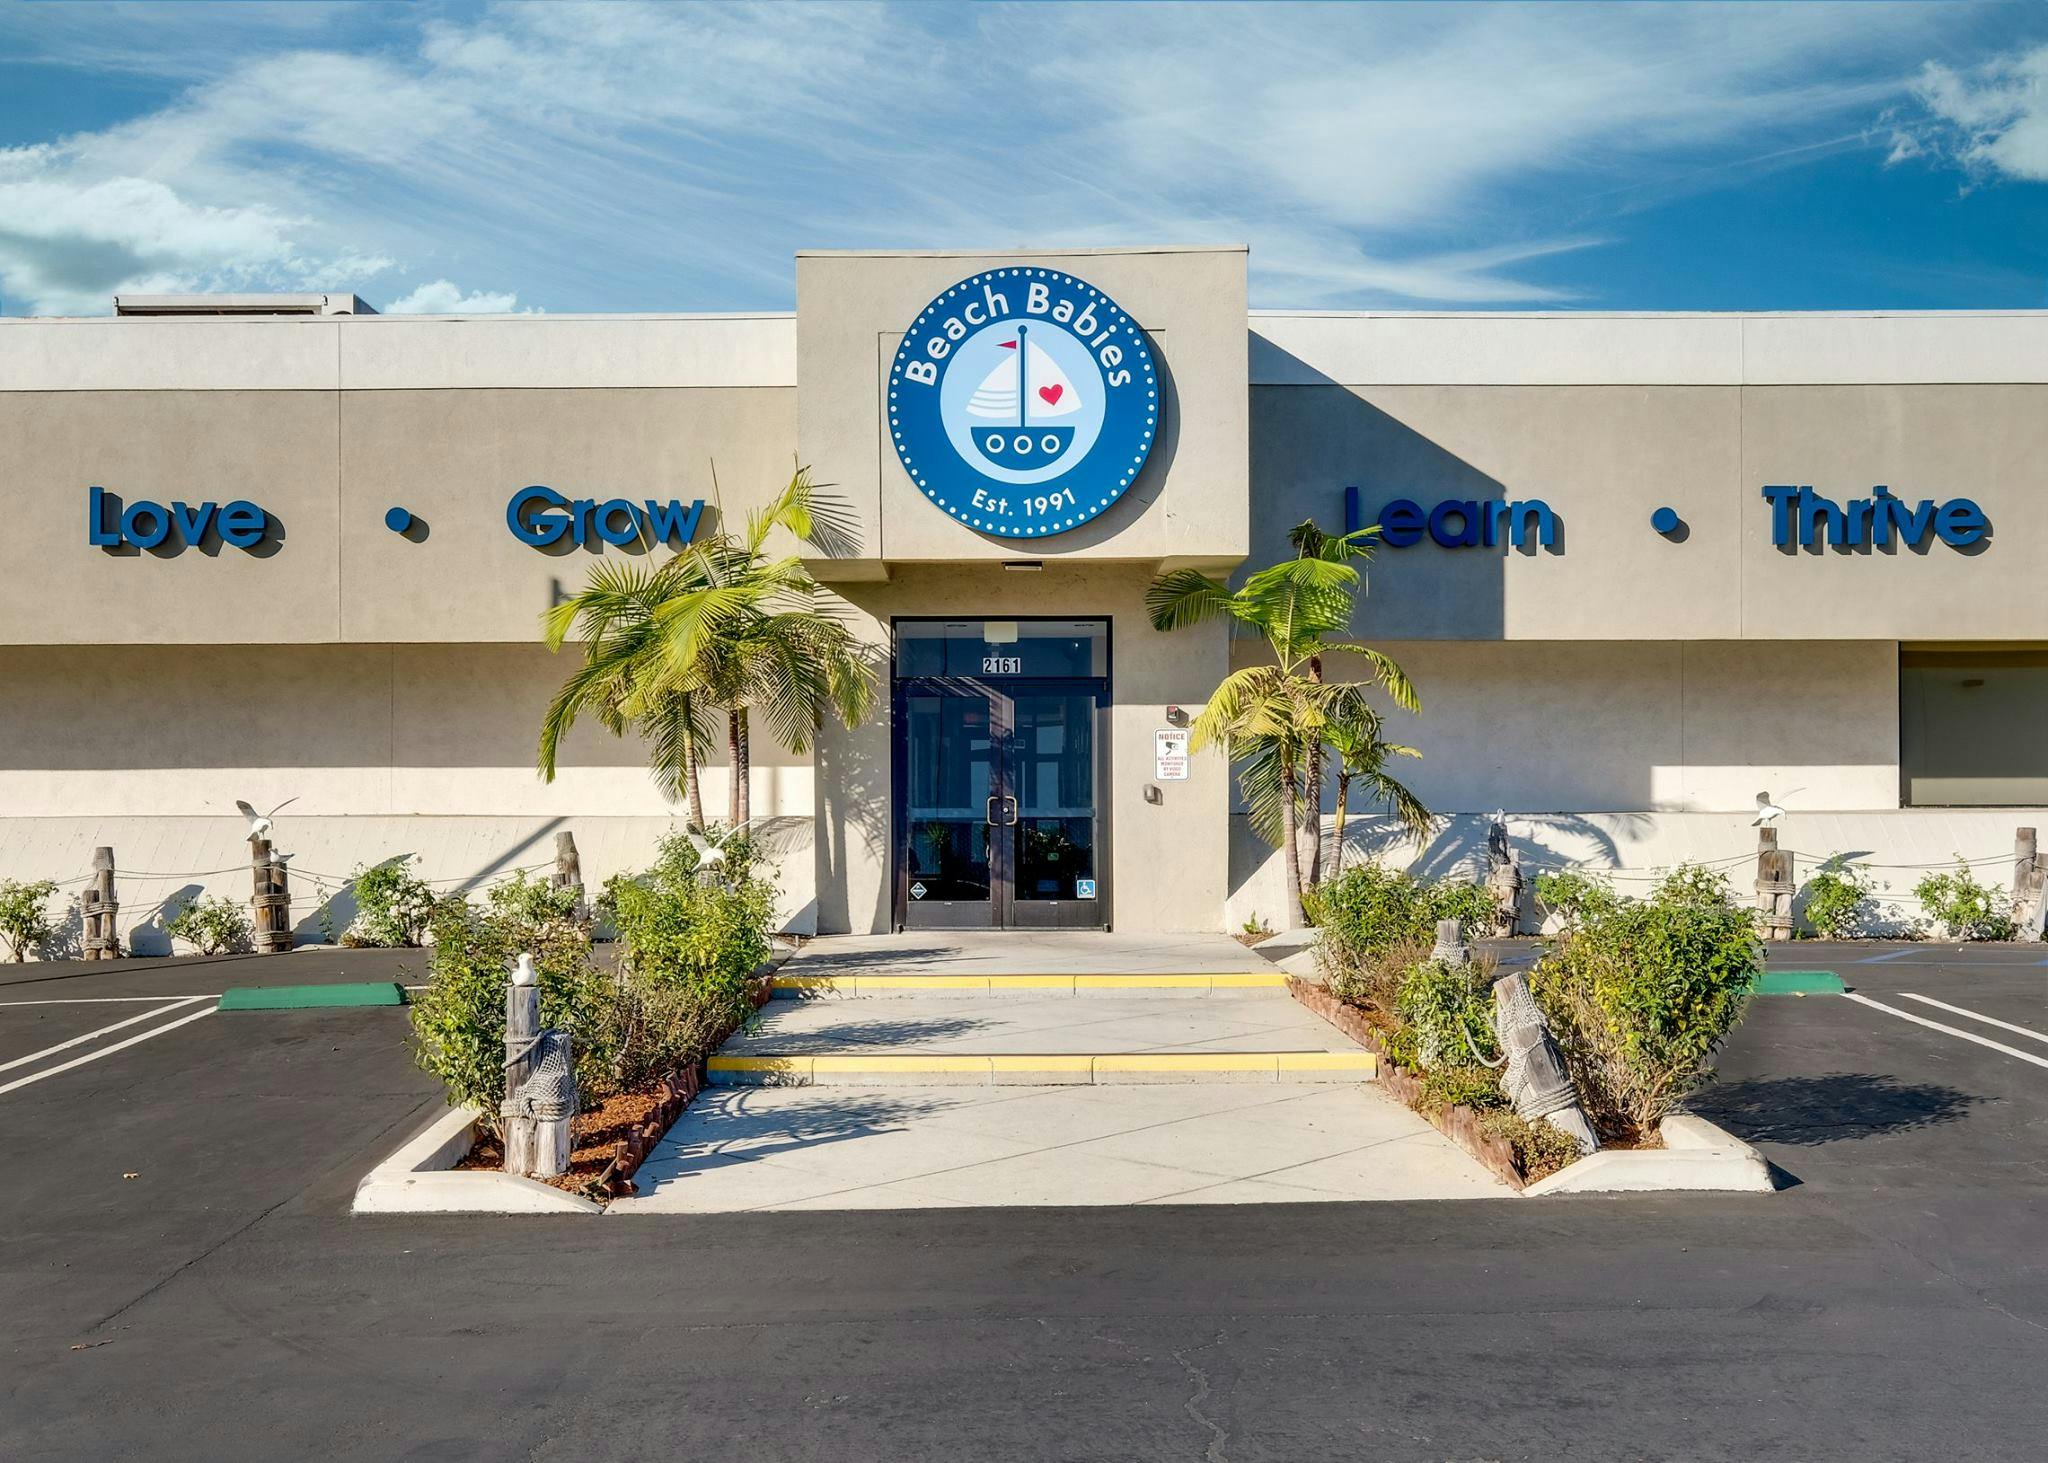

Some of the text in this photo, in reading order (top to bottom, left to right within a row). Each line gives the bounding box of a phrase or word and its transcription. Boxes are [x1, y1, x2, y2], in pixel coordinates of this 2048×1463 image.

[904, 282, 1131, 387] Beach Babies
[89, 485, 705, 548] Love Grow
[971, 488, 1076, 516] Est. 1991
[1345, 485, 1986, 548] Learn Thrive
[984, 658, 1019, 673] 2161
